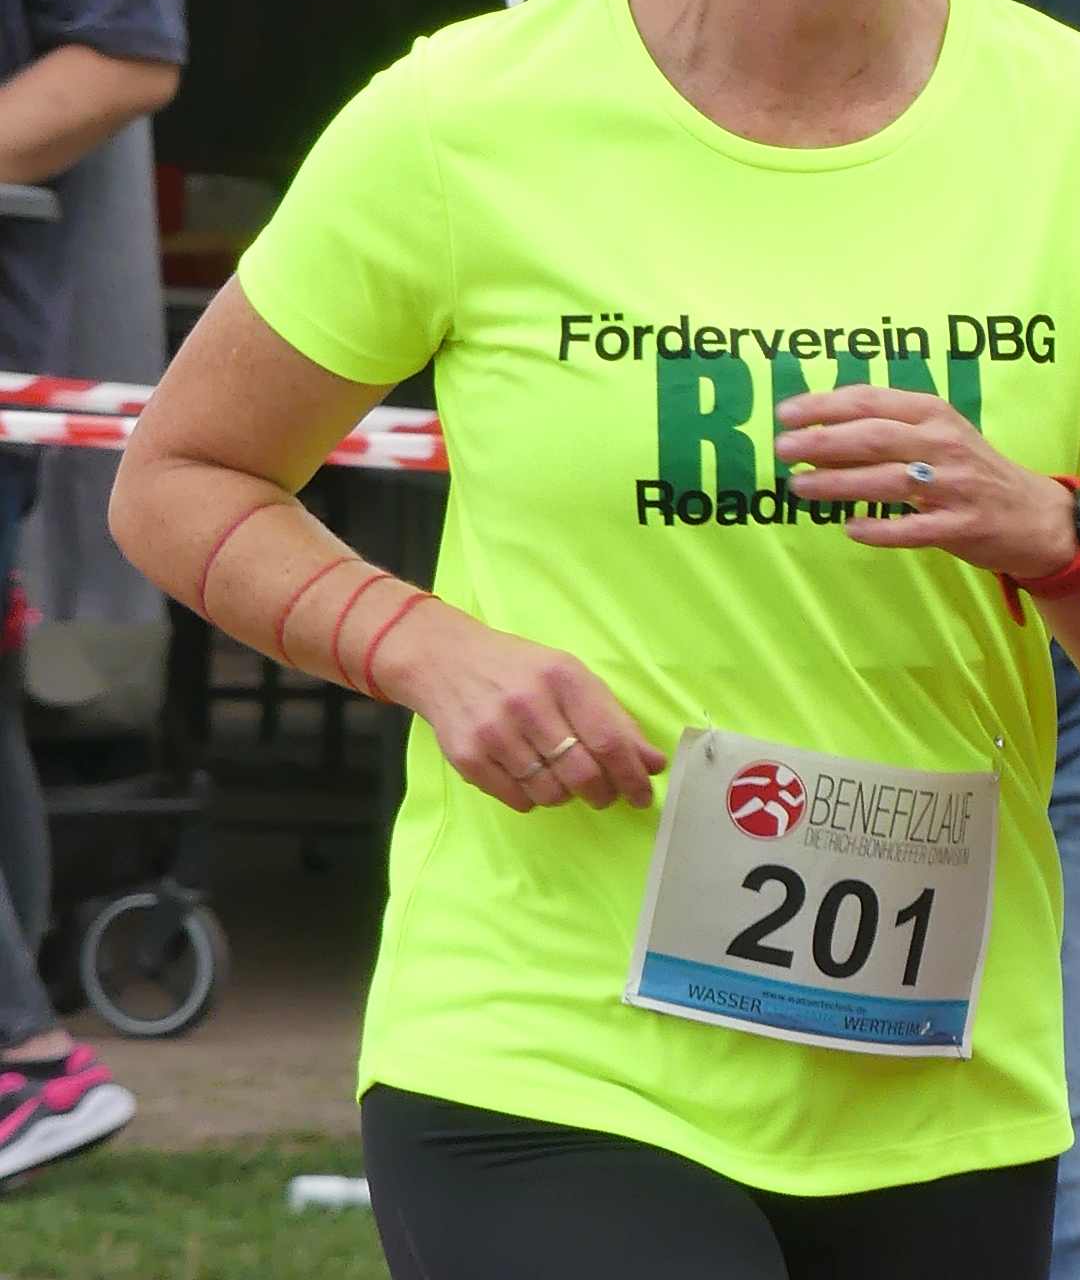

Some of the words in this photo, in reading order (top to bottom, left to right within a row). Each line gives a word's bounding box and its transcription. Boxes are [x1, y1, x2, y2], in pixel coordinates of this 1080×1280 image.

[558, 313, 930, 362] Förderverein
[947, 313, 1056, 363] DBG
[808, 773, 974, 846] BENEFIZLAUF
[725, 863, 936, 988] 201
[687, 983, 763, 1015] WASSER
